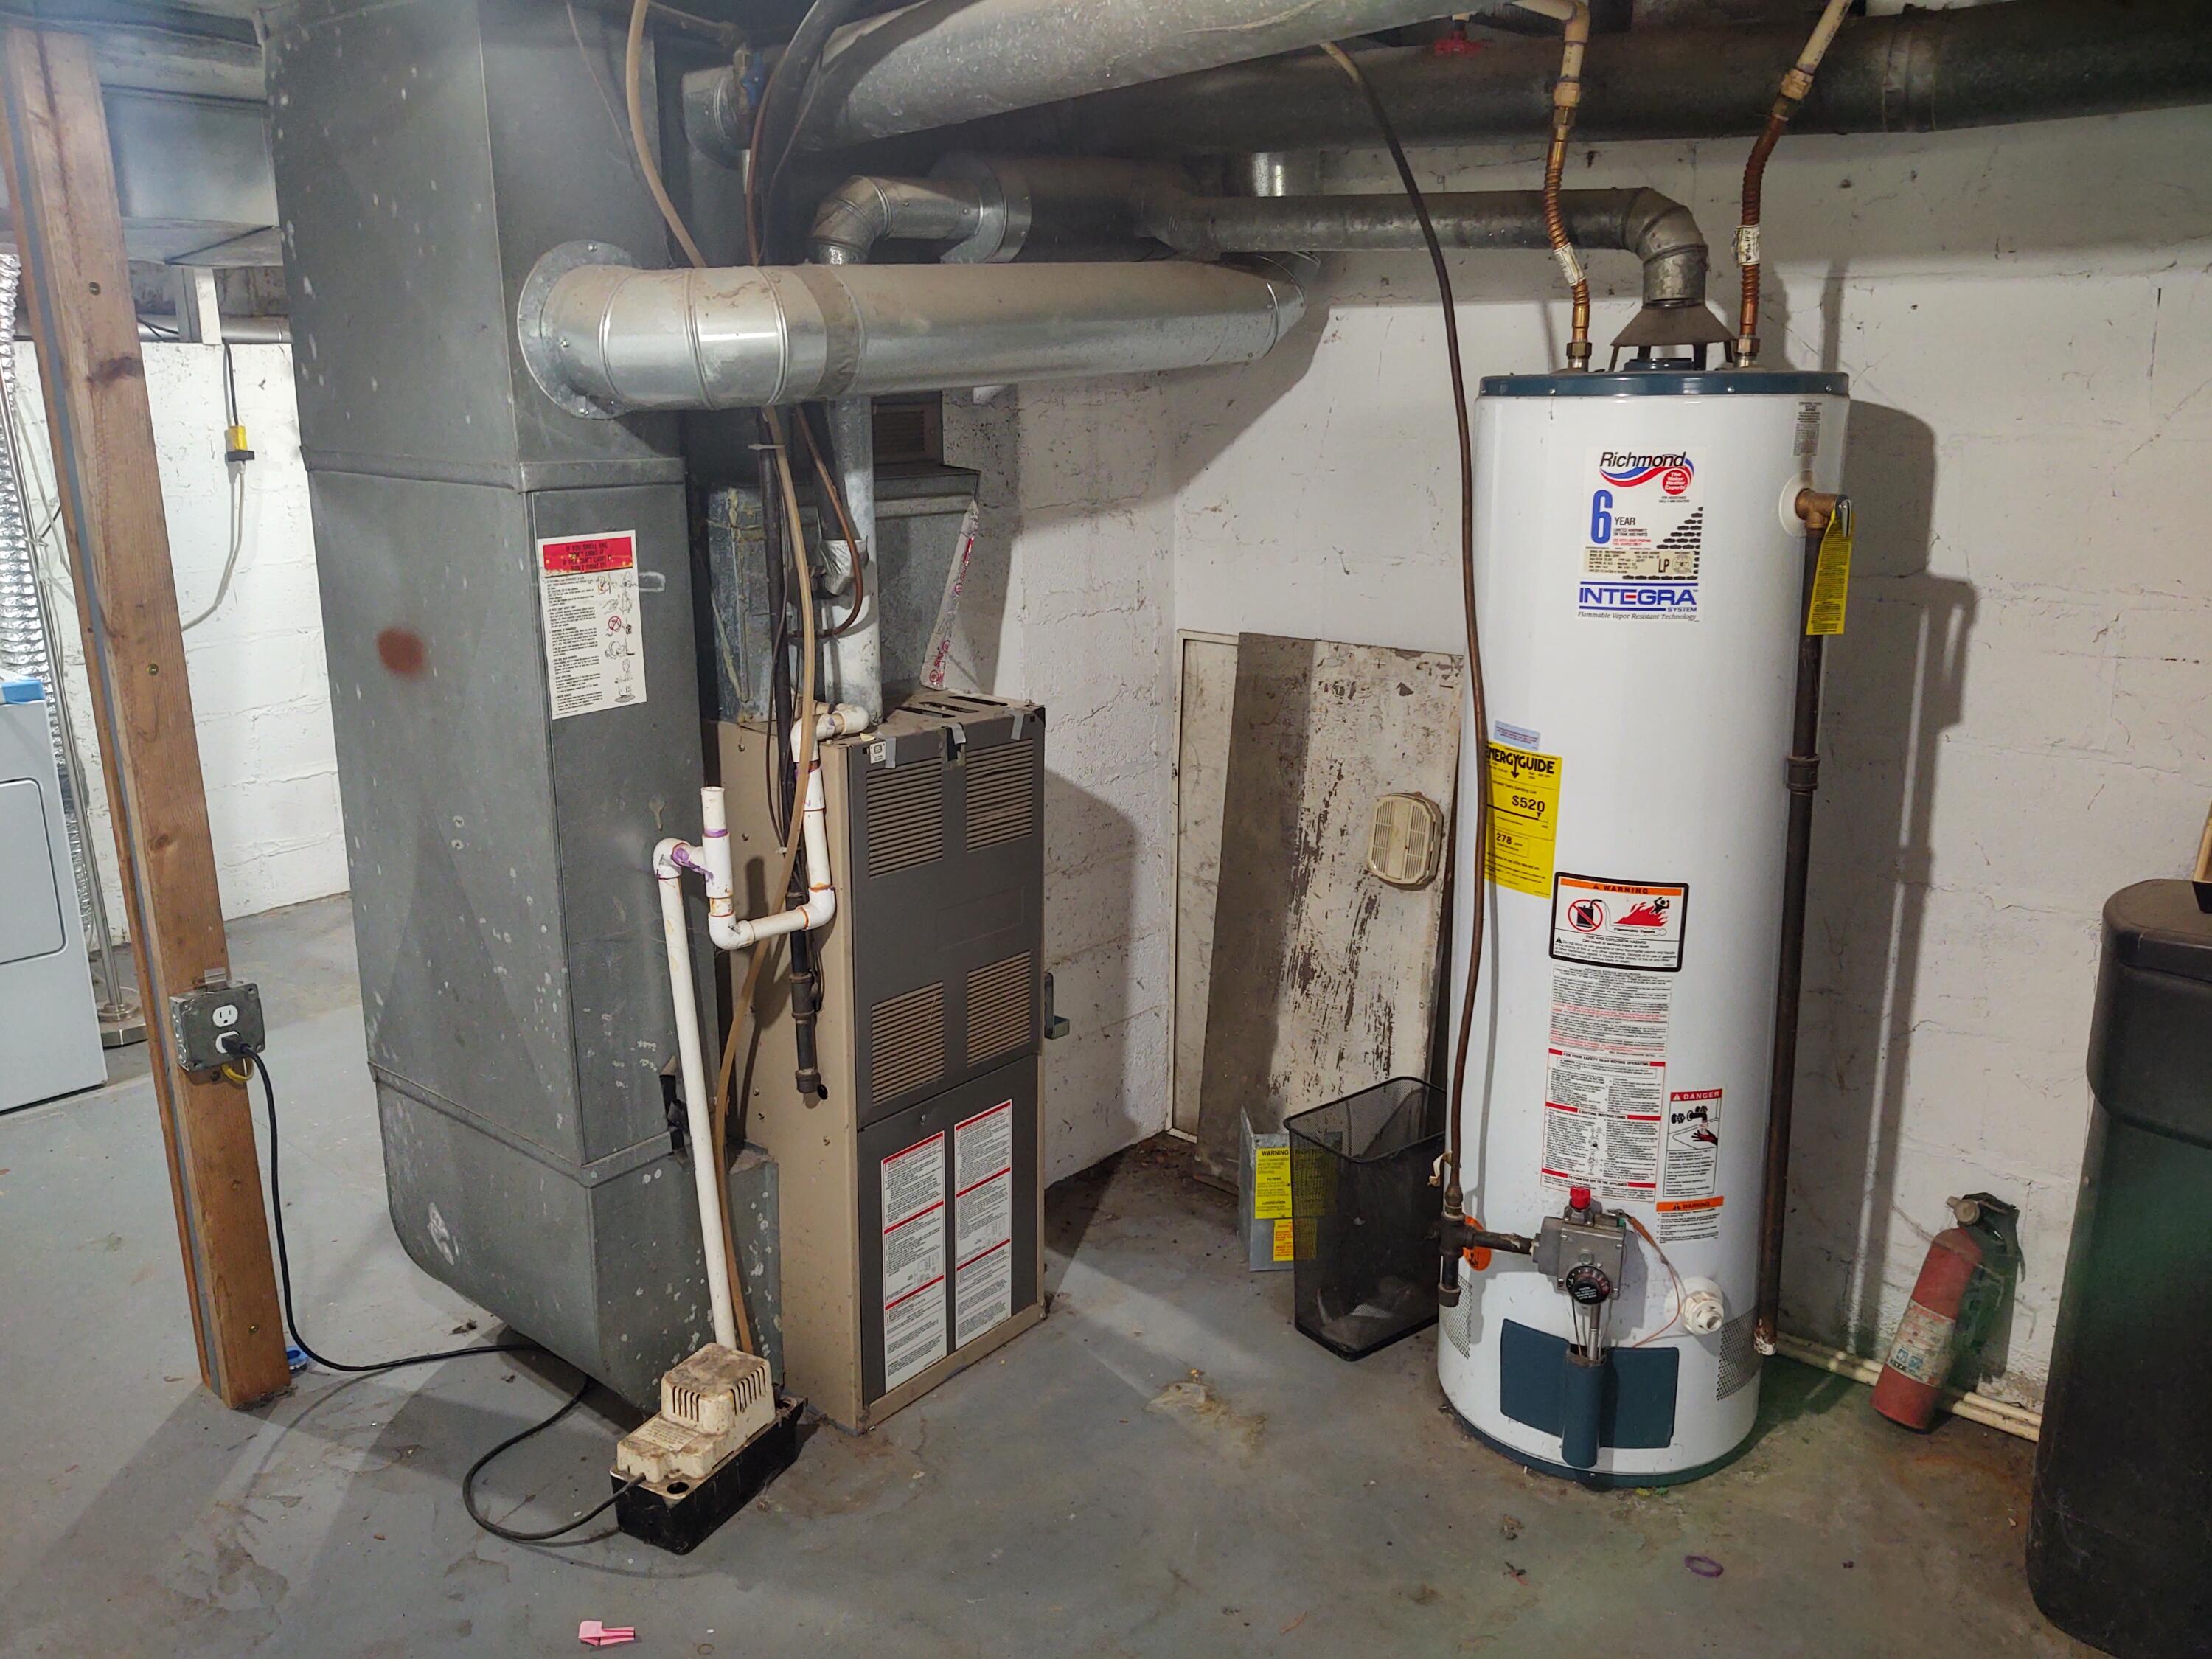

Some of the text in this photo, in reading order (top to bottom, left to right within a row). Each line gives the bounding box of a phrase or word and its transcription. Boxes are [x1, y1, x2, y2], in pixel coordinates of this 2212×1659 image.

[1599, 451, 1687, 467] Richmond
[1591, 490, 1636, 544] 6 YEAR
[1658, 558, 1670, 573] LP
[1579, 587, 1697, 605] INTEGRA
[1496, 832, 1512, 844] 278
[1603, 884, 1649, 894] WARNING
